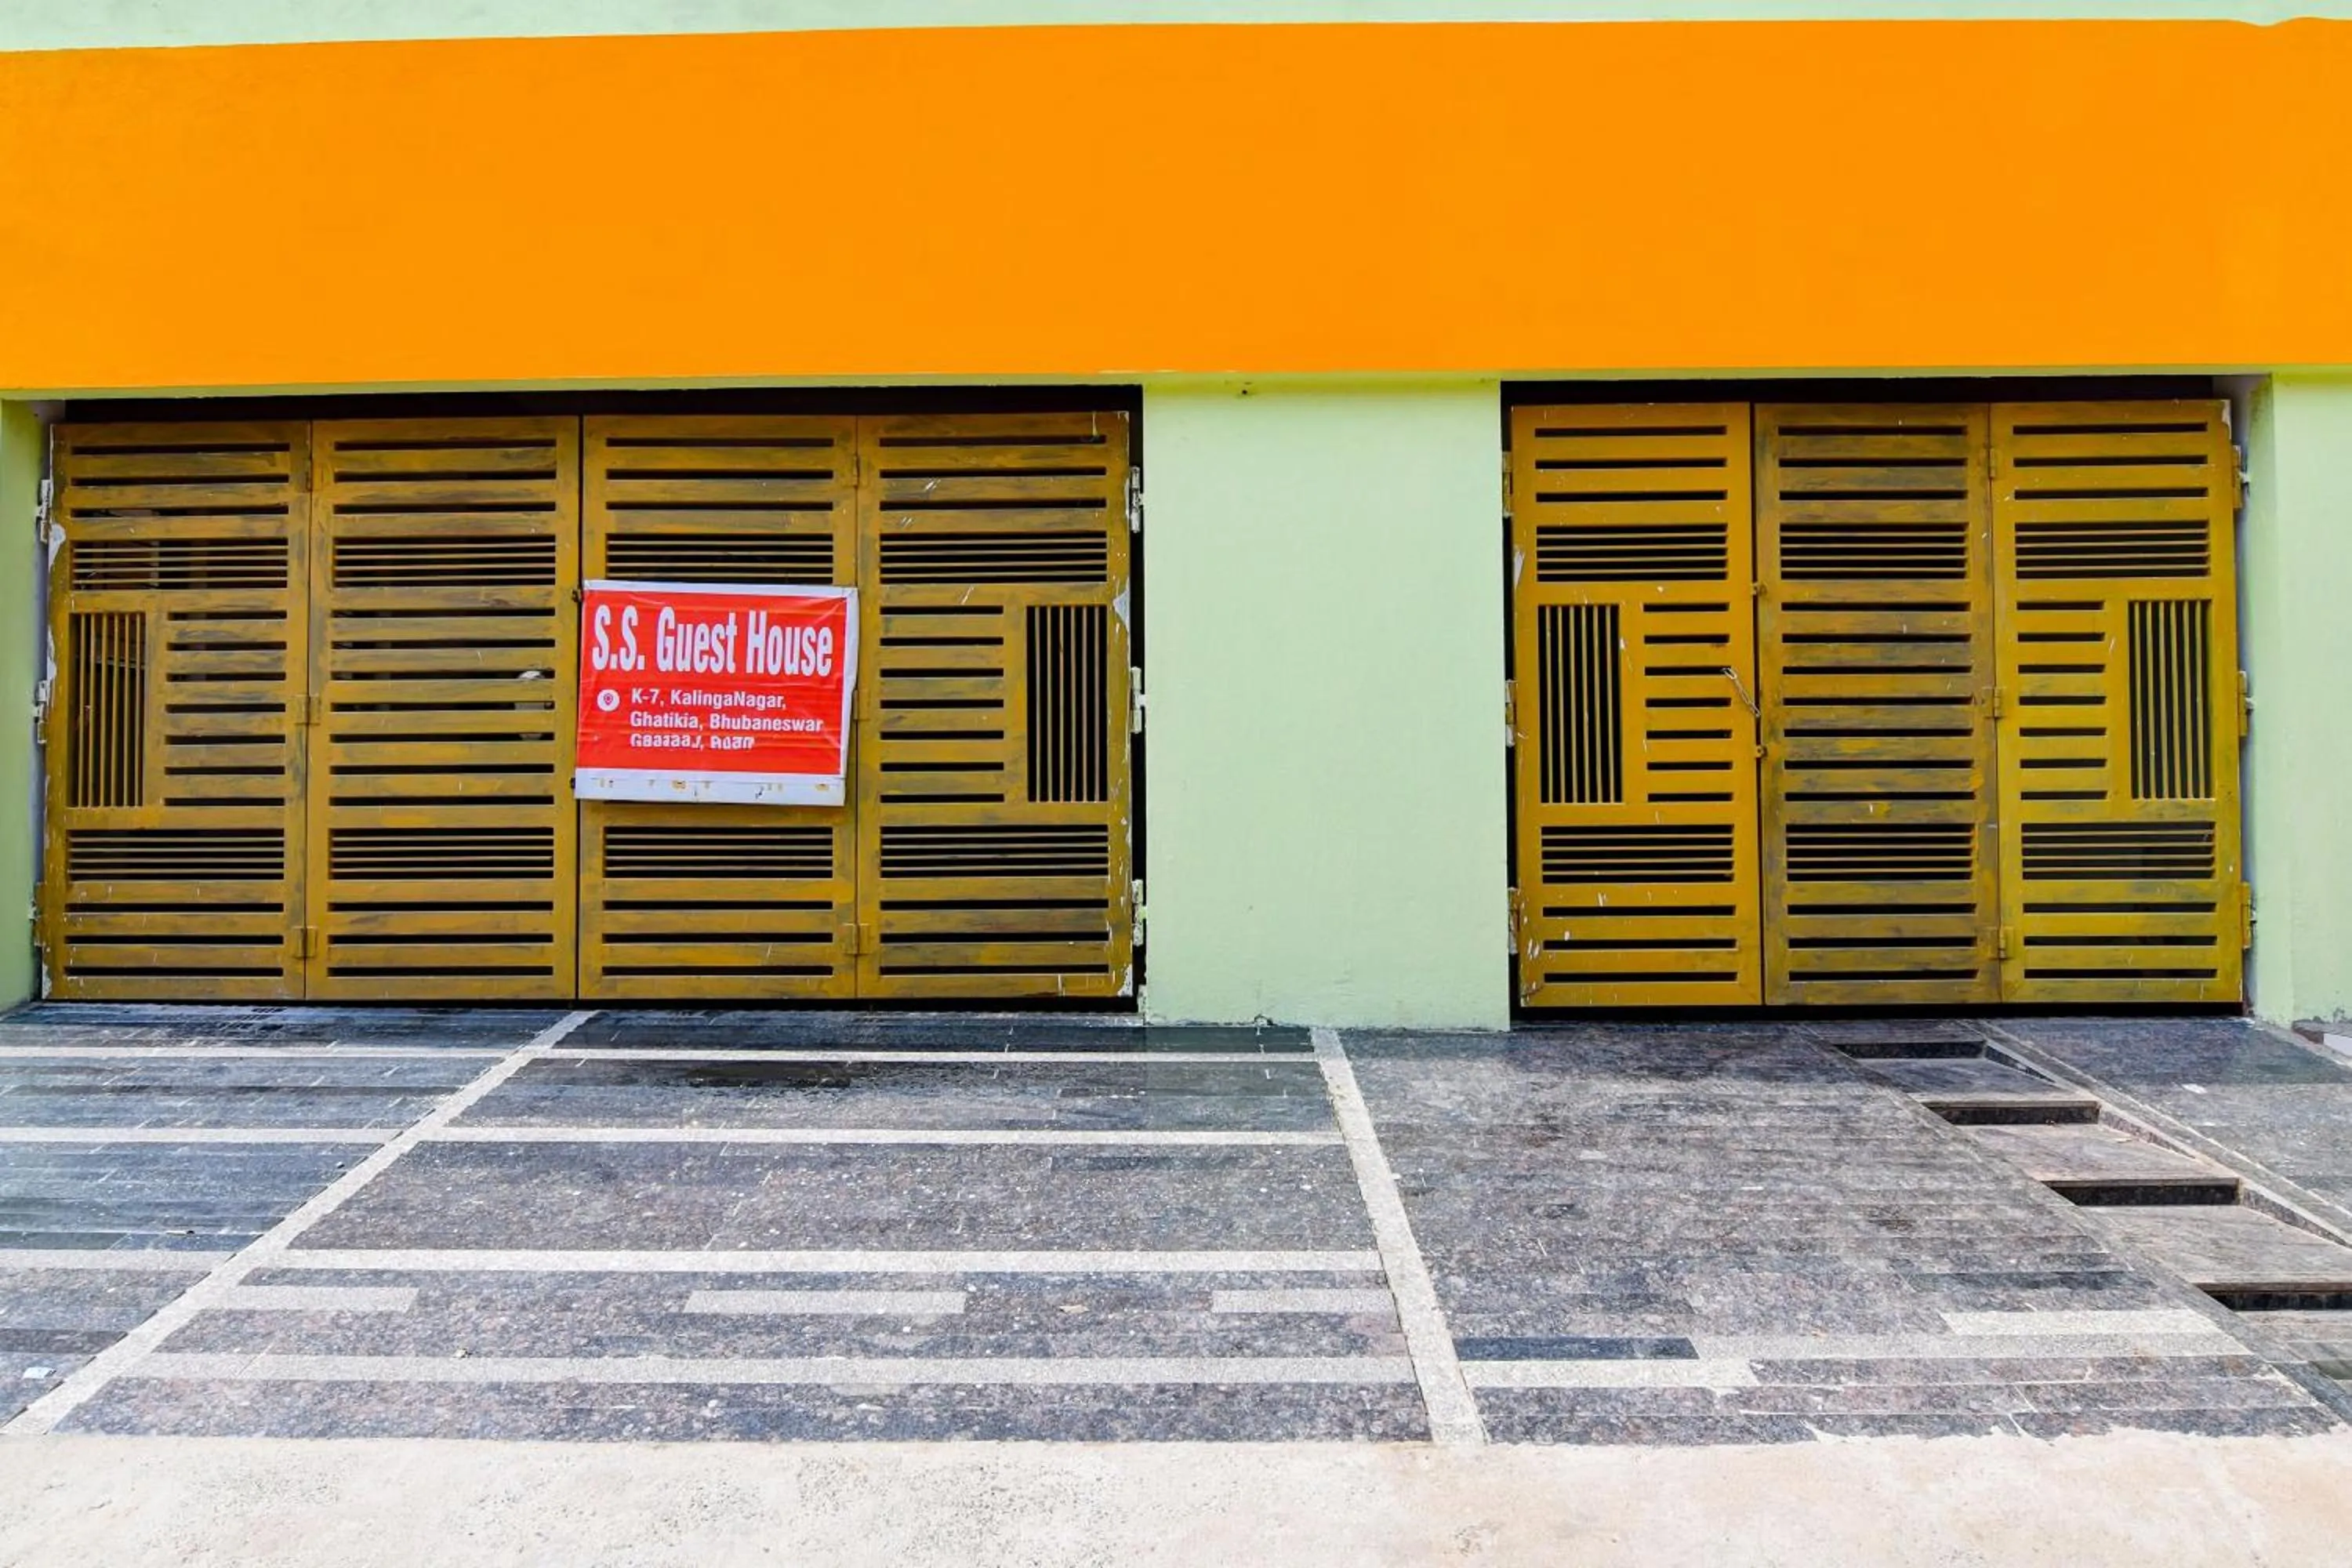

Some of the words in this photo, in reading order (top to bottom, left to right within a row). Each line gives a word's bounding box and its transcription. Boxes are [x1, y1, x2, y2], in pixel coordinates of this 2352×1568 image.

[593, 604, 644, 671] S.S.
[657, 607, 737, 673] Guest
[746, 610, 833, 676] House
[632, 688, 664, 706] K-7,
[671, 690, 786, 710] KalingaNagar,
[631, 711, 703, 730] Ghatikia,
[710, 713, 824, 731] Bhubaneswar
